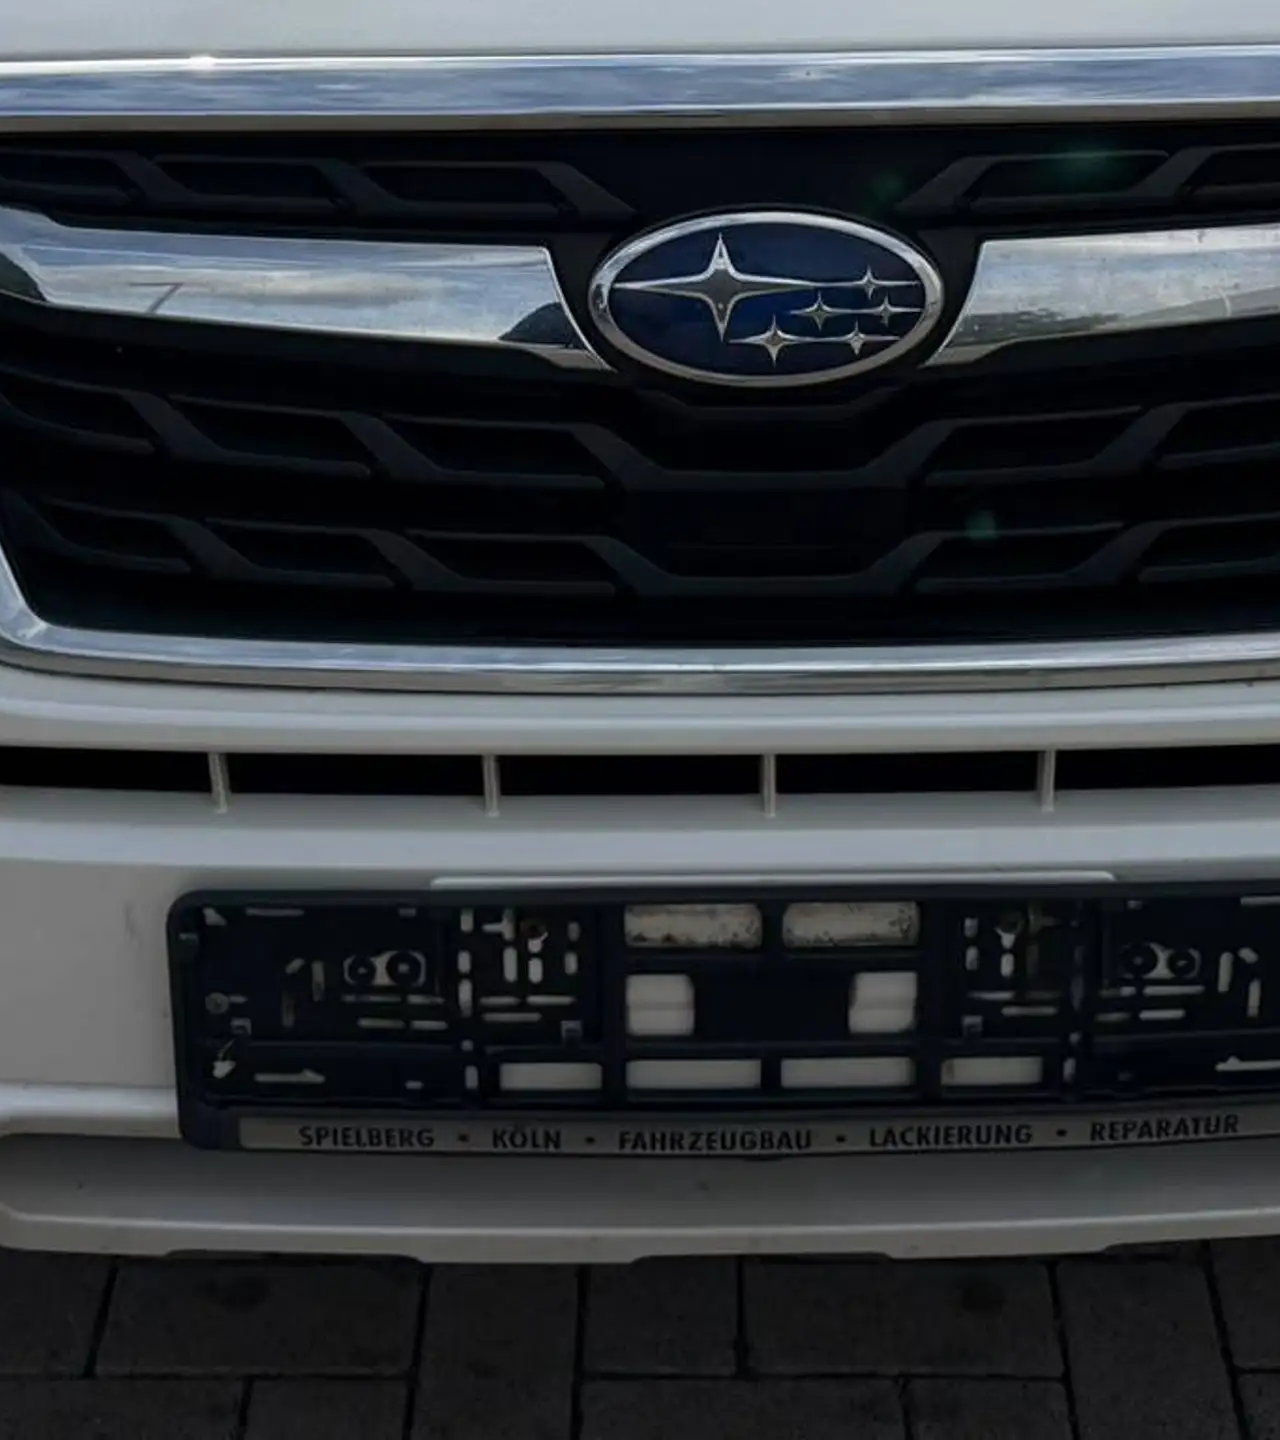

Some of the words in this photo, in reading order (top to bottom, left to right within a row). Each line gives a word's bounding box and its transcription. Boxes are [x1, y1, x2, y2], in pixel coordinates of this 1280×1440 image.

[298, 1125, 435, 1148] SPIELBERG
[492, 1123, 562, 1150] KÖLN
[619, 1128, 812, 1151] FAHRZEUGBAU
[869, 1123, 1032, 1147] LACKIERUNG
[1090, 1114, 1239, 1141] REPARATUR
